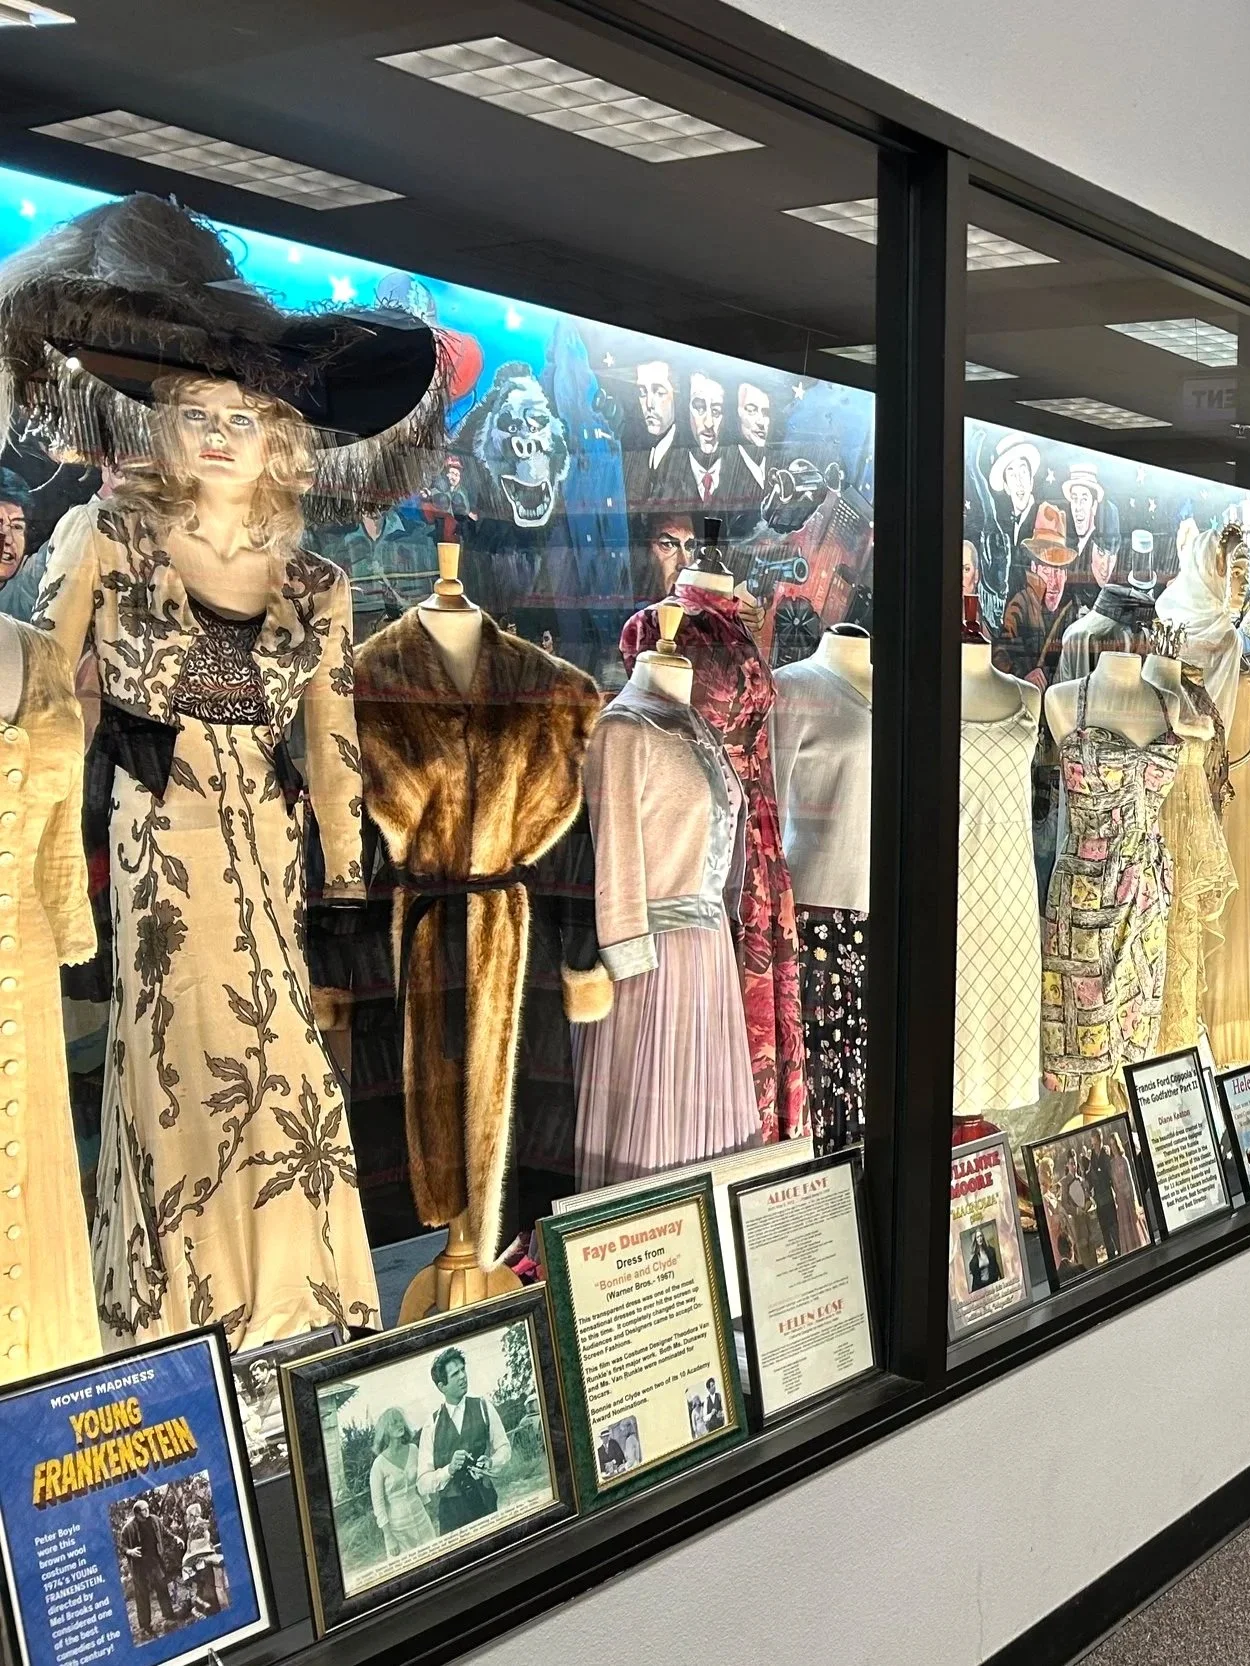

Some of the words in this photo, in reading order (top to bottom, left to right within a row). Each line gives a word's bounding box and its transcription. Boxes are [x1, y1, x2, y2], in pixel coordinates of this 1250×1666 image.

[1135, 1081, 1156, 1094] Francis
[1157, 1075, 1169, 1089] Ford
[1170, 1069, 1197, 1085] Coppola's
[1139, 1095, 1151, 1107] The
[1151, 1085, 1179, 1102] Godfather
[1180, 1082, 1191, 1094] Part
[1191, 1080, 1198, 1089] II
[1158, 1114, 1173, 1125] Diane
[1173, 1108, 1191, 1120] Keaton
[951, 1150, 1000, 1180] LIANNE
[768, 1185, 801, 1204] ALICE
[803, 1176, 828, 1195] FAYE
[950, 1171, 994, 1200] MOORE
[582, 1241, 617, 1262] Faye
[619, 1219, 683, 1250] Dunaway
[594, 1272, 632, 1291] "Bonnie
[634, 1265, 651, 1279] and
[652, 1253, 681, 1272] Clyde"
[616, 1254, 643, 1270] Dress
[644, 1247, 665, 1261] from
[606, 1287, 633, 1302] (Warner
[779, 1312, 815, 1334] HELEN
[817, 1298, 844, 1318] ROSE
[583, 1348, 604, 1361] Screen
[604, 1340, 632, 1354] Fashions.
[50, 1386, 93, 1409] MOVIE
[96, 1369, 155, 1396] MADNESS
[654, 1381, 665, 1389] two
[686, 1361, 710, 1376] Academy
[588, 1390, 612, 1402] Oscars.
[69, 1396, 143, 1446] YOUNG
[592, 1411, 612, 1425] Award
[612, 1397, 648, 1416] Nominations.
[32, 1415, 198, 1510] FRANKENSTEIN
[34, 1531, 57, 1546] Peter
[58, 1523, 81, 1538] Boyle
[37, 1544, 58, 1558] wore
[59, 1538, 76, 1550] this
[39, 1553, 66, 1569] brown
[67, 1544, 87, 1558] wool
[41, 1562, 78, 1581] costume
[79, 1558, 87, 1566] in
[43, 1576, 70, 1593] 1974's
[71, 1564, 98, 1582] YOUNG
[47, 1596, 82, 1616] directed
[83, 1592, 94, 1604] by
[50, 1614, 65, 1627] Mel
[66, 1604, 94, 1621] Brooks
[94, 1596, 110, 1610] and
[52, 1614, 97, 1639] considered
[98, 1609, 113, 1621] one
[54, 1639, 64, 1650] of
[65, 1633, 80, 1646] the
[80, 1626, 99, 1640] best
[56, 1640, 96, 1662] comedies
[97, 1635, 106, 1646] of
[107, 1630, 121, 1641] the
[80, 1644, 115, 1665] century!
